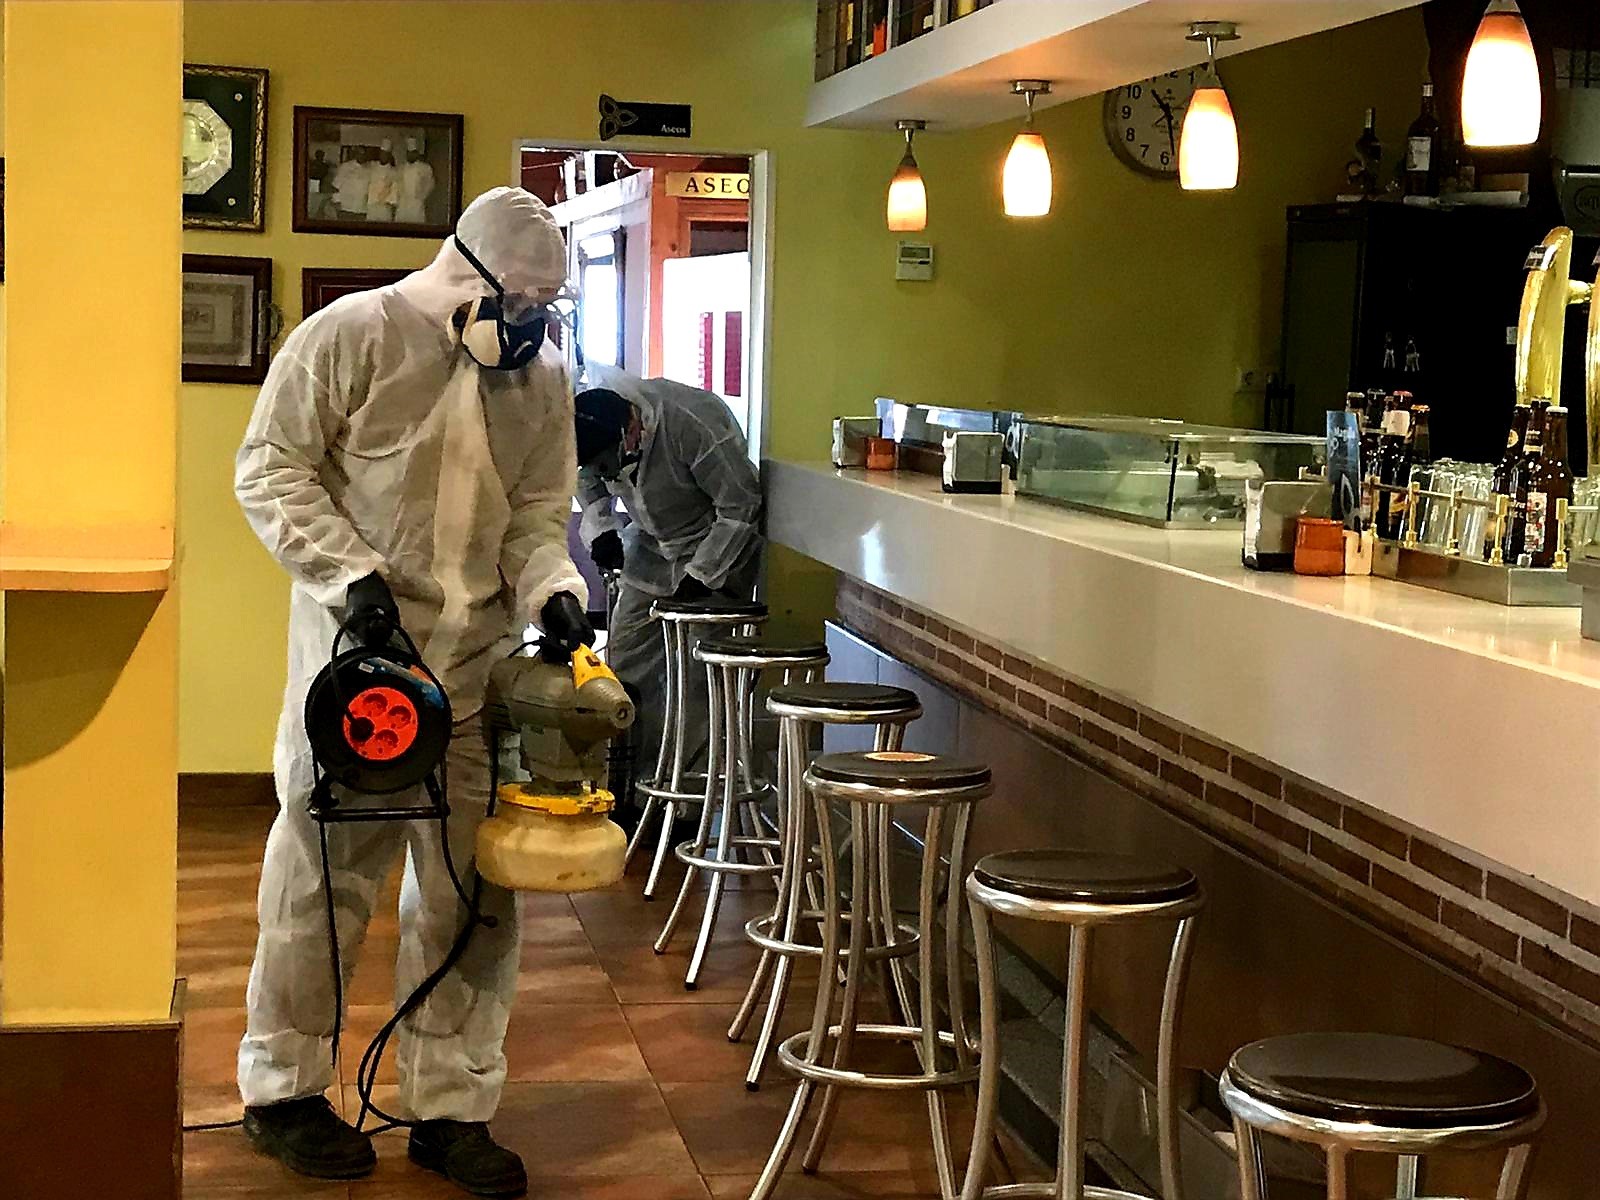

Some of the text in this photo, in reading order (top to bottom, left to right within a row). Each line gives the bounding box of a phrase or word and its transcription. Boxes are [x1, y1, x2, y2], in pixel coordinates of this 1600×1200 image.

[1126, 85, 1142, 99] 10
[1122, 105, 1132, 119] 9
[1126, 127, 1135, 142] 8
[1140, 144, 1150, 158] 7
[1160, 152, 1170, 166] 6
[685, 177, 750, 194] ASEO
